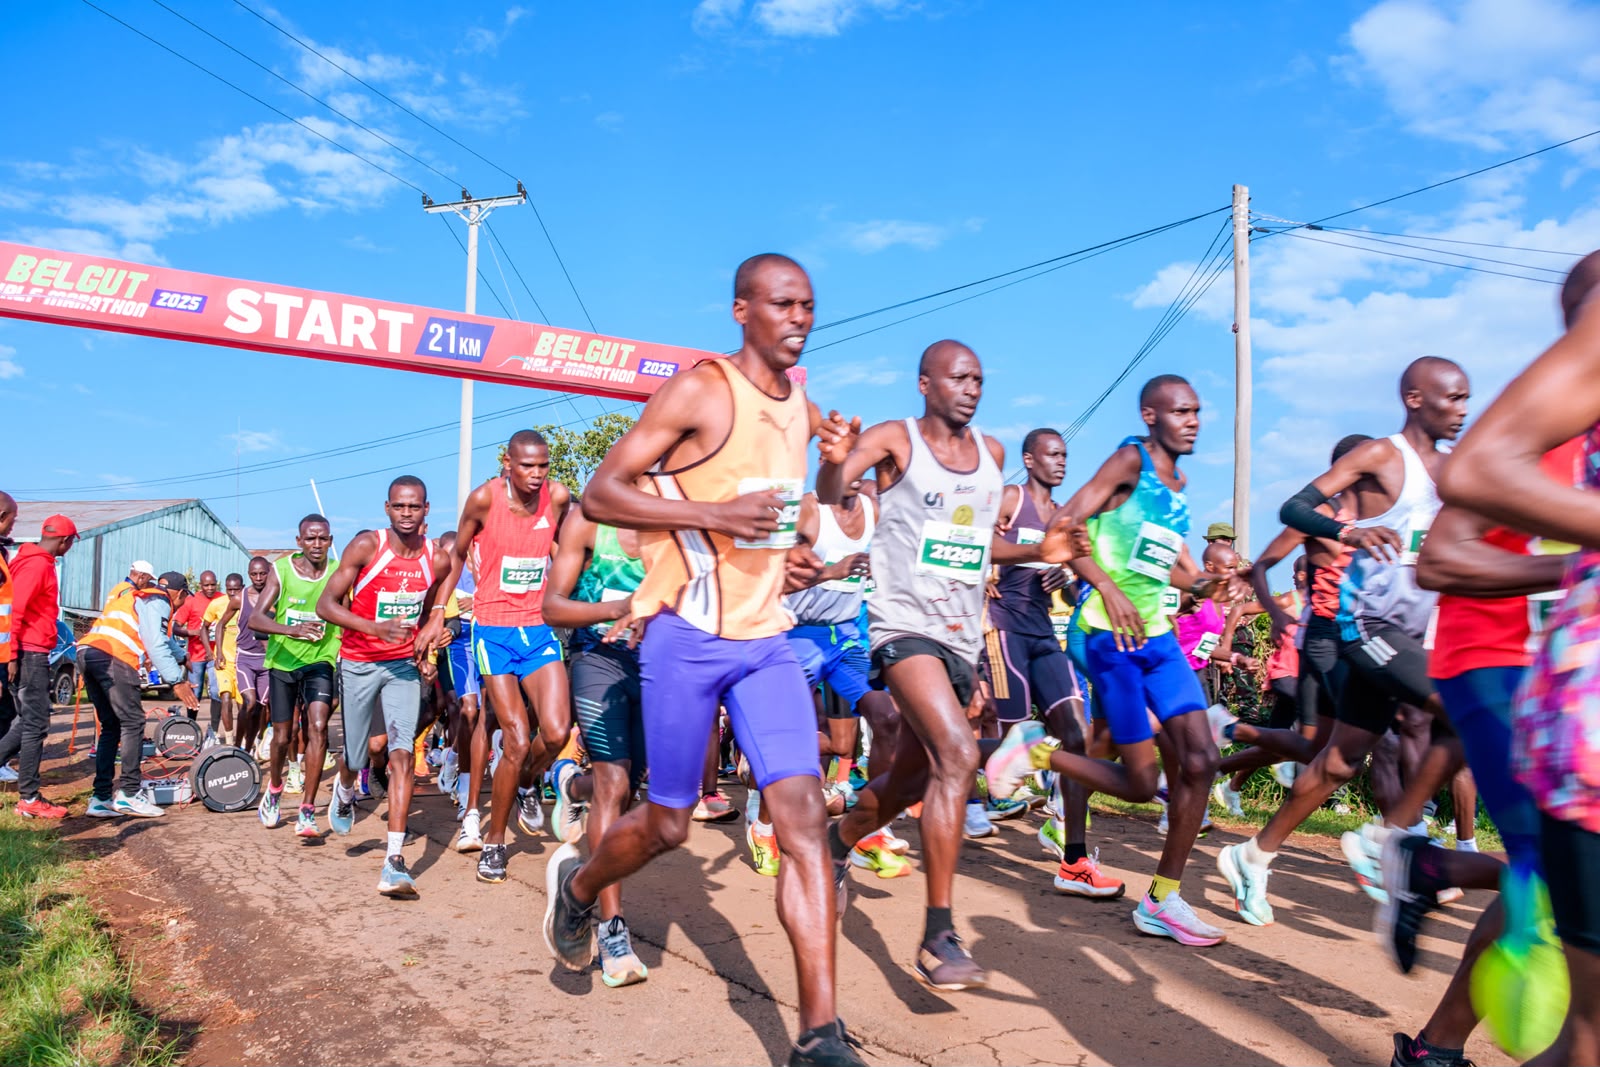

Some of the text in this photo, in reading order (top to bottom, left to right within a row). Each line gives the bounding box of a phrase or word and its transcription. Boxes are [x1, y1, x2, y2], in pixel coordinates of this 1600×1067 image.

[5, 254, 149, 299] BELGUT
[43, 290, 149, 318] MARATHON
[156, 292, 203, 311] 2025
[223, 288, 414, 353] START
[533, 332, 636, 367] BELGUT
[522, 356, 636, 384] HALF MARATHON
[641, 361, 676, 377] 2025
[208, 770, 249, 788] MYLAPS
